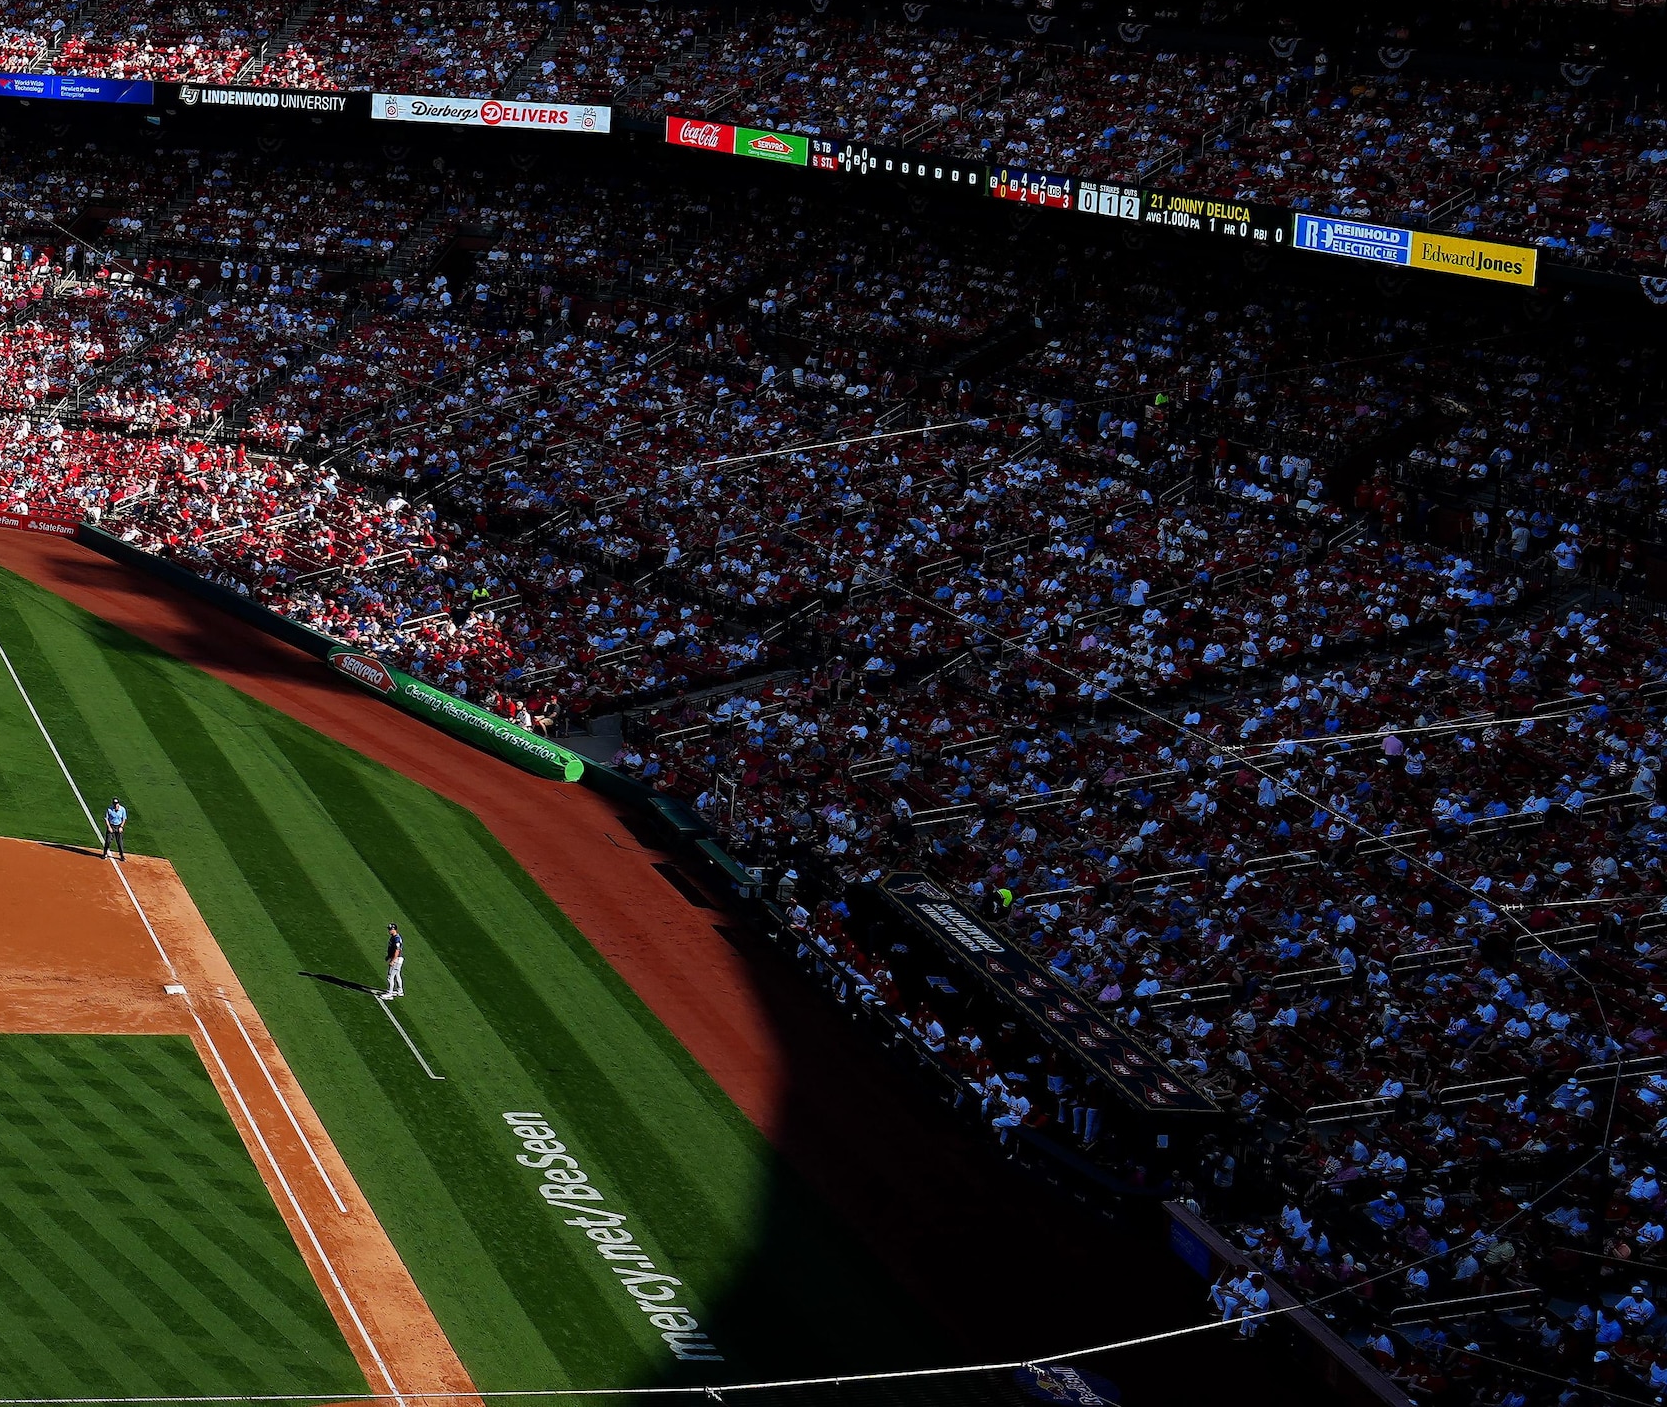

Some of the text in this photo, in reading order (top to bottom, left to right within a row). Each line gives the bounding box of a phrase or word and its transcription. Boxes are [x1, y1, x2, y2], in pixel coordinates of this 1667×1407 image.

[202, 90, 346, 112] LINDENWOOD UNIVERSITY
[411, 100, 478, 121] Dierbergs
[679, 121, 721, 147] Coca-Cola
[1167, 196, 1251, 223] JONNY DELUCA
[1333, 223, 1401, 244] REINHOLD
[1332, 241, 1382, 259] ELECTRIC
[1422, 243, 1523, 276] Edward Jones
[341, 655, 384, 685] SERVPRO
[503, 1112, 724, 1361] mercy.net/BeSeen
